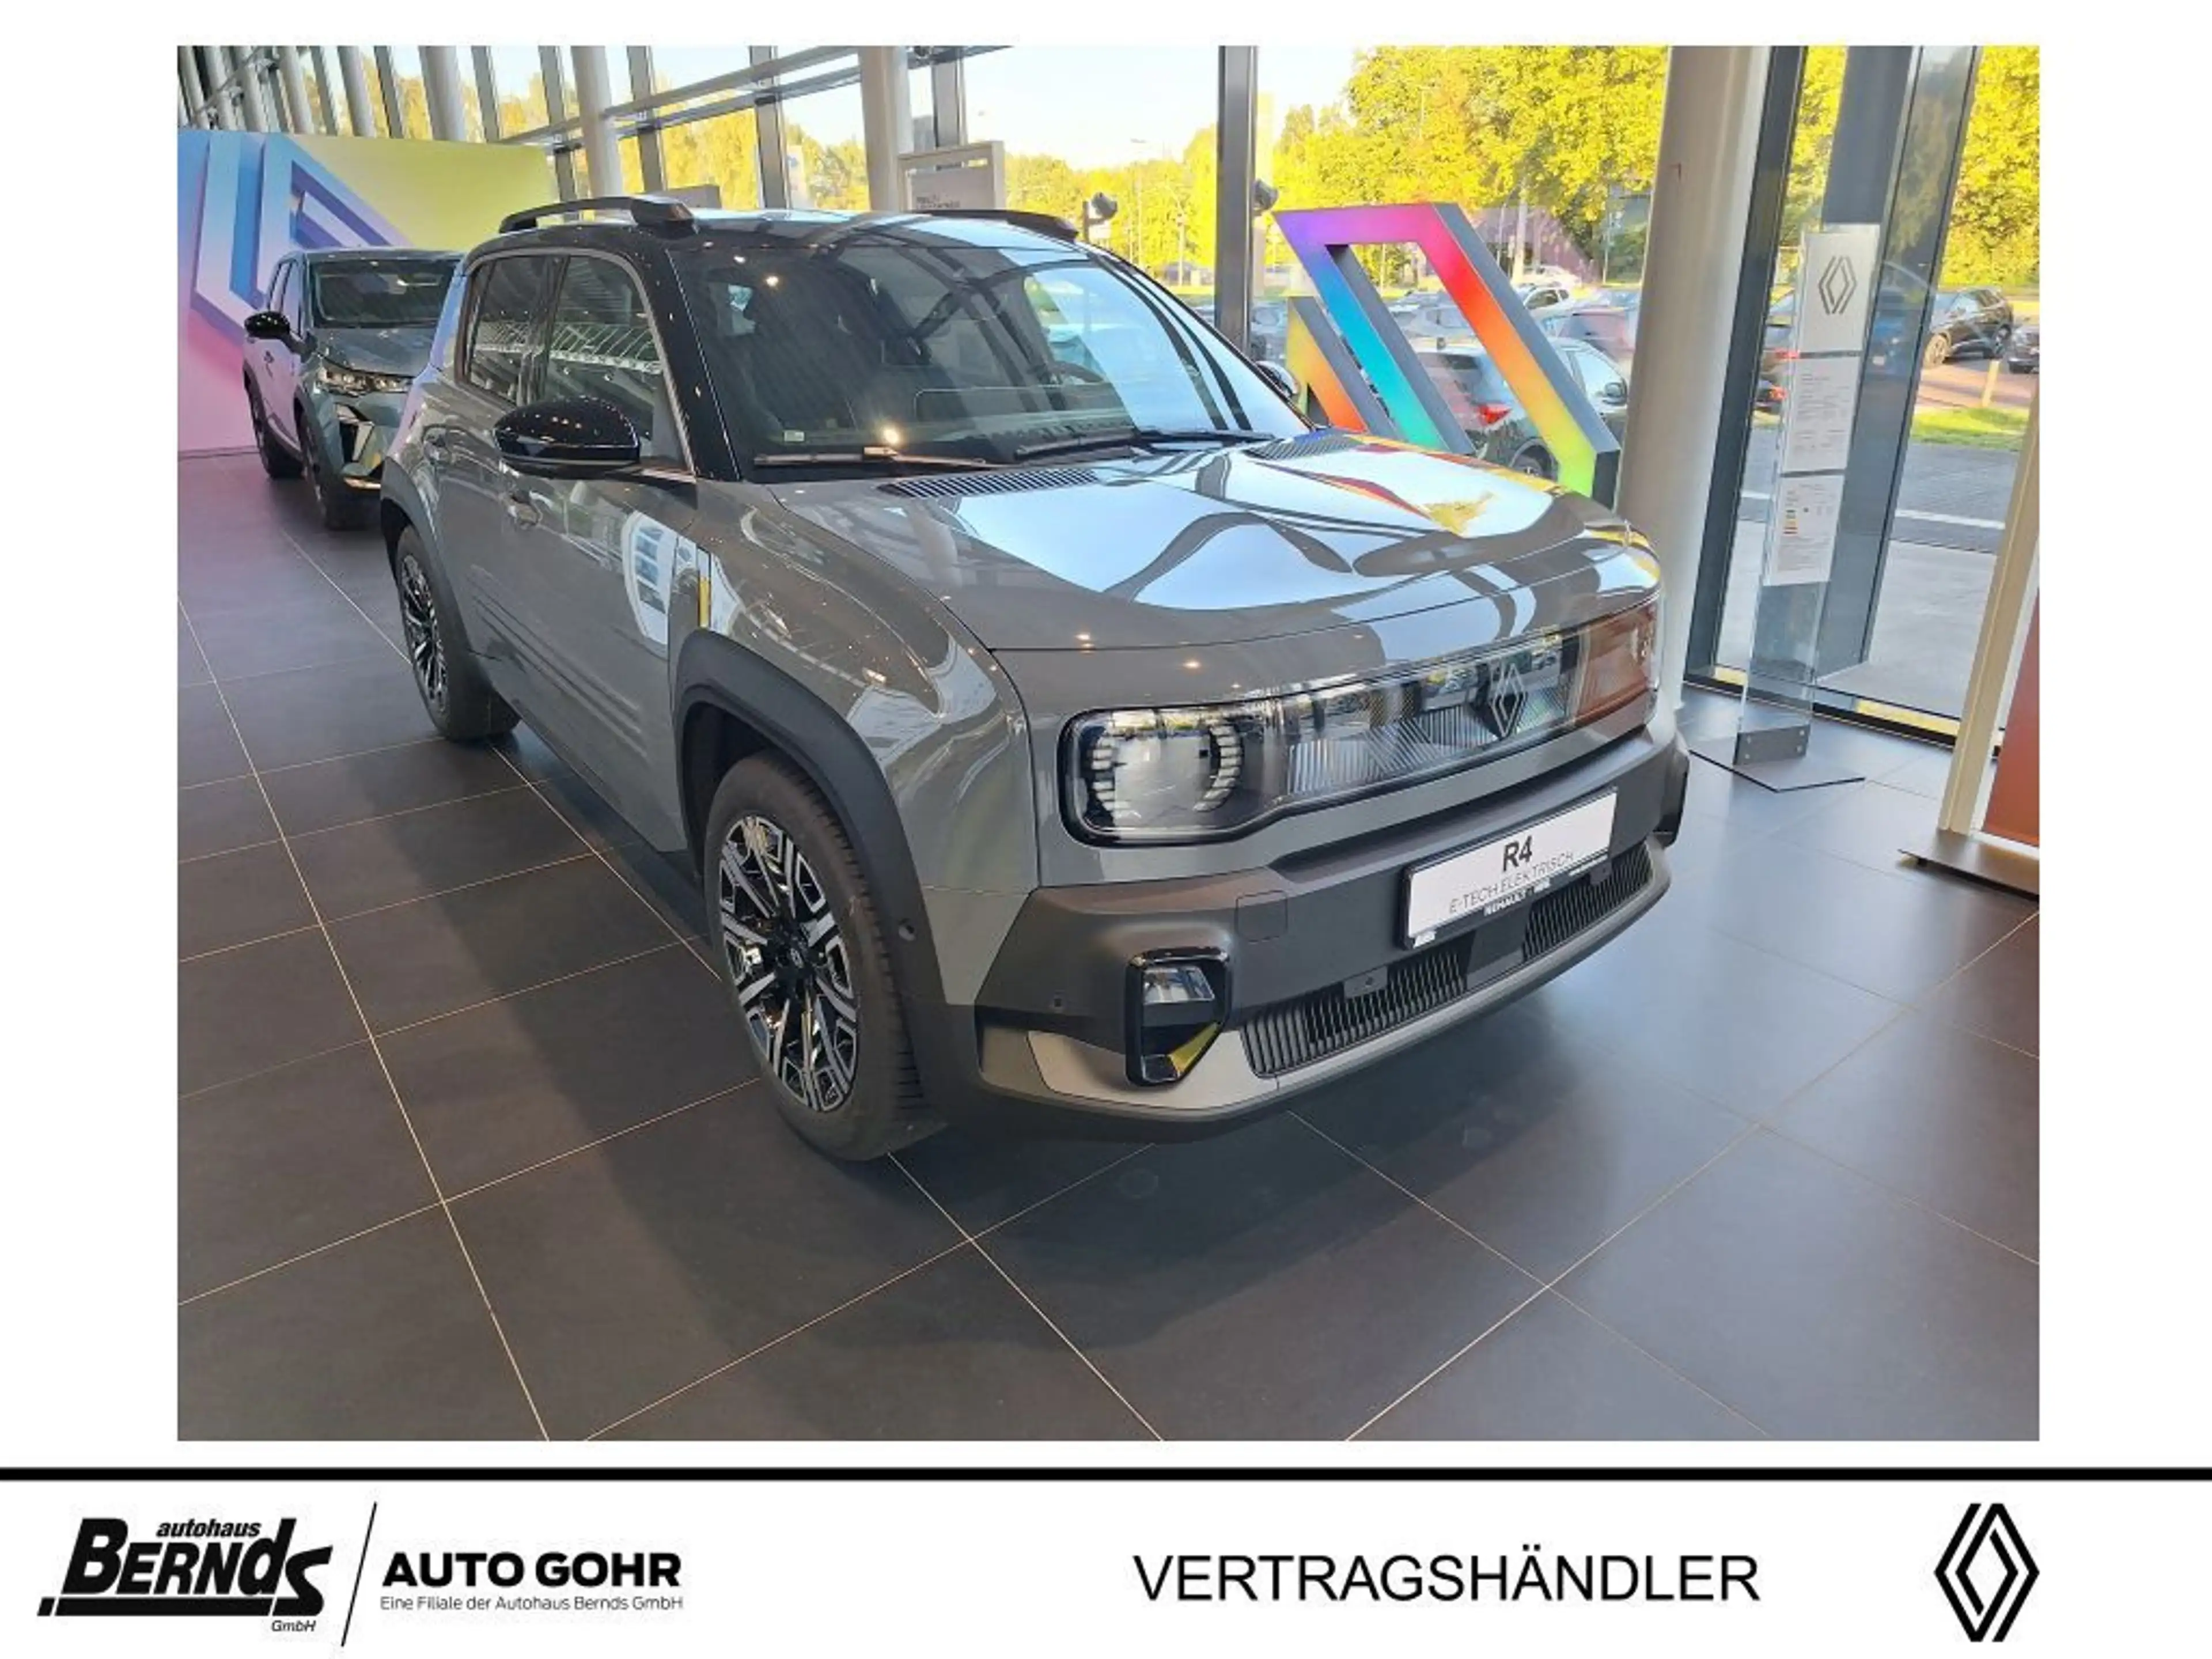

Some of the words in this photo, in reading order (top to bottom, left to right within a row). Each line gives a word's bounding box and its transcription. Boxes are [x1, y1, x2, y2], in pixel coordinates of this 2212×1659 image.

[1503, 835, 1532, 872] R4
[1449, 882, 1498, 914] E-TECH
[1501, 851, 1574, 893] ELEKTRISCH
